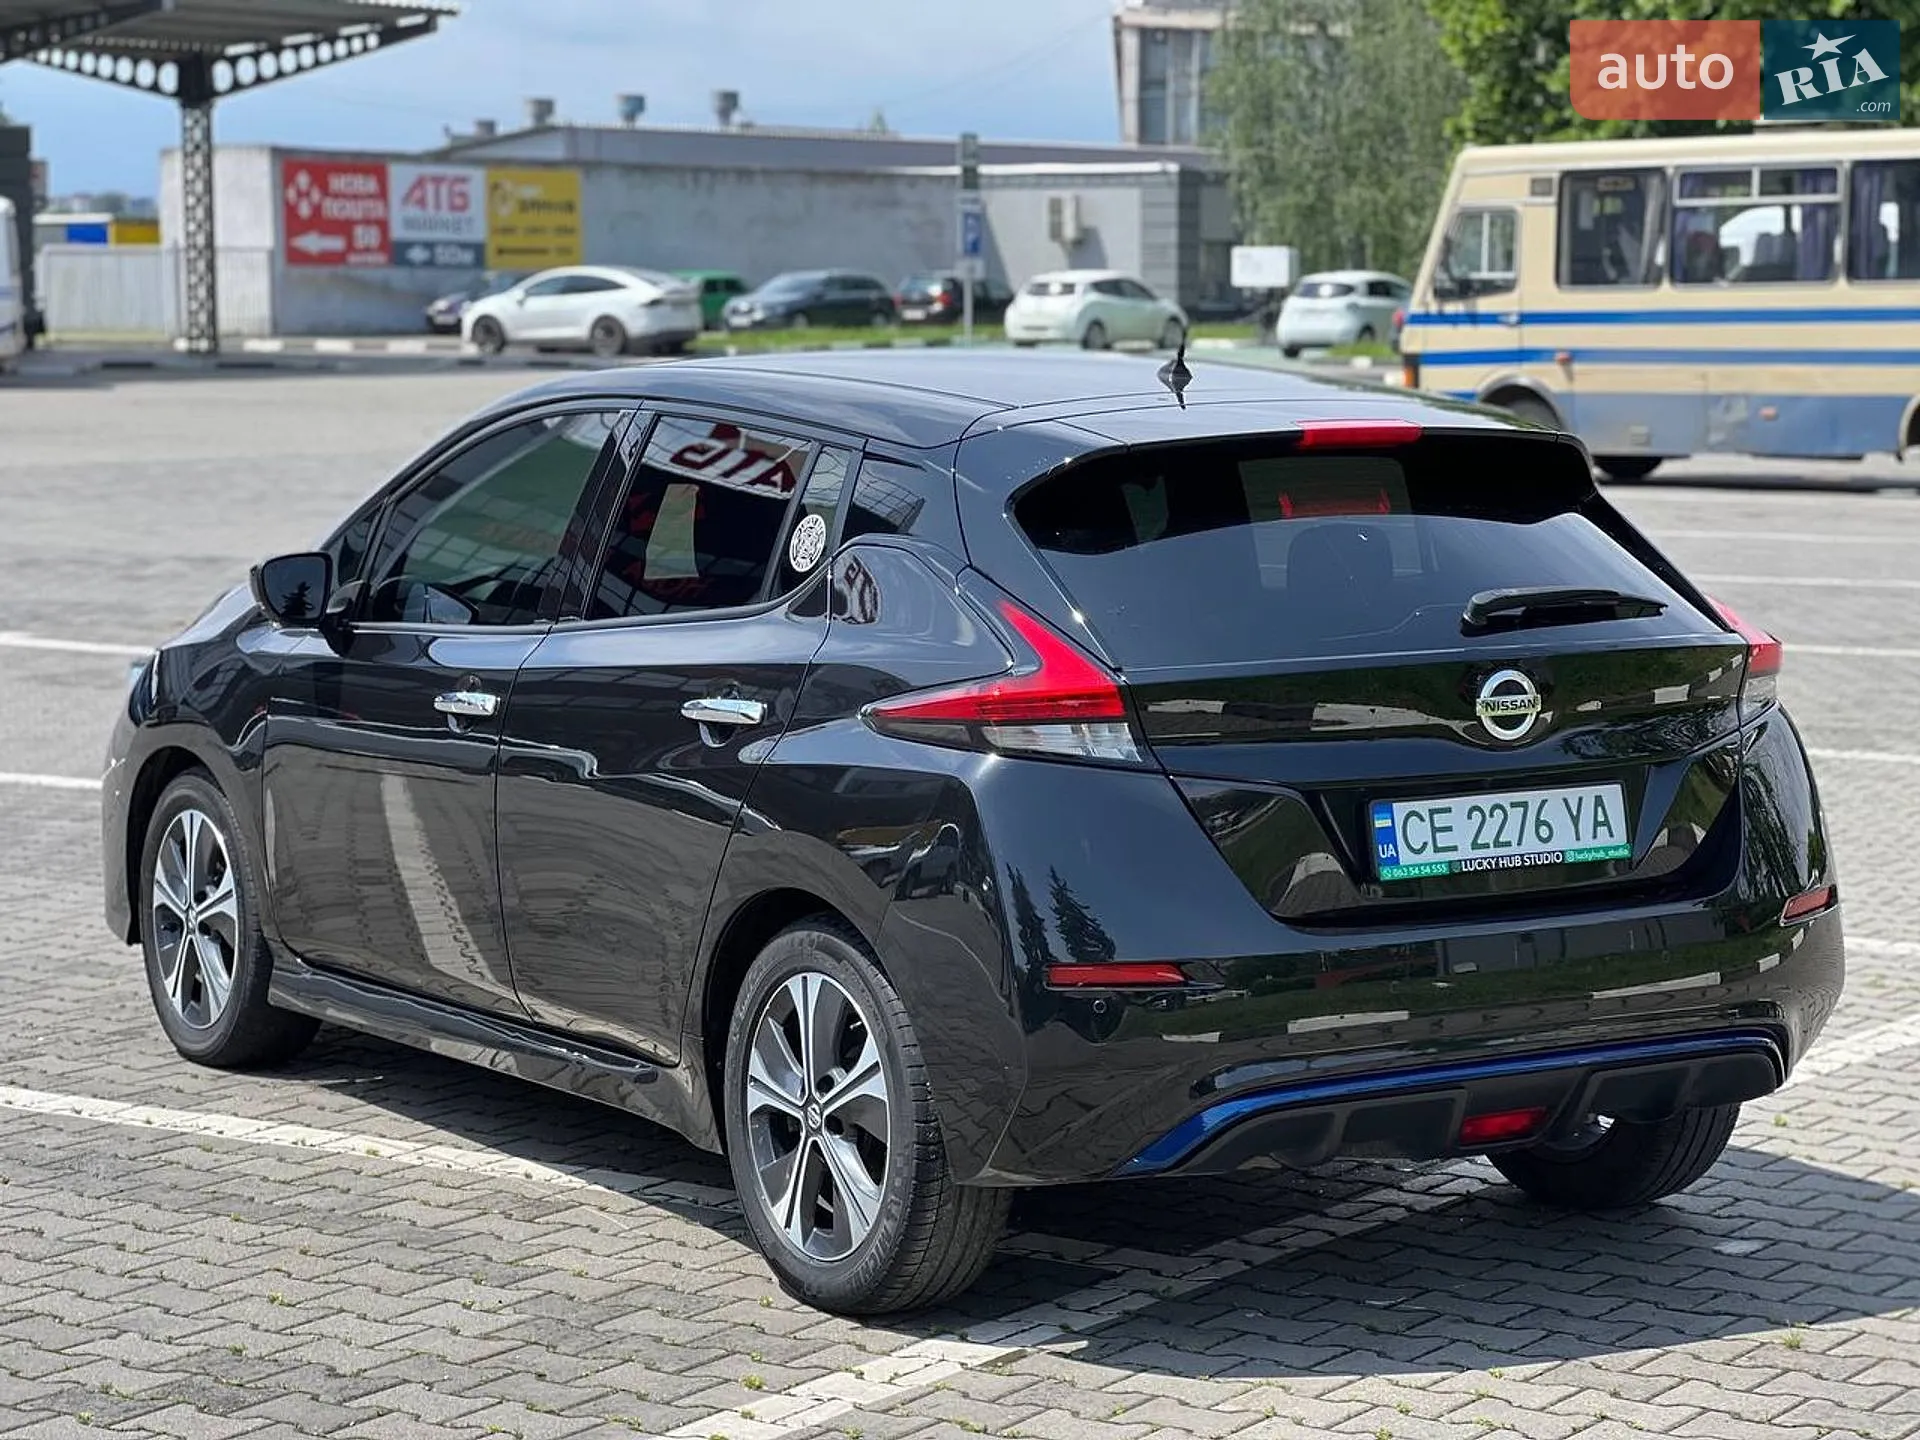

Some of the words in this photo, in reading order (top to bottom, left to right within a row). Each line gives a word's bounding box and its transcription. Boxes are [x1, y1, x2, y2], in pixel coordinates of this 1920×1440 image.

[327, 172, 380, 194] НОВА
[402, 173, 473, 212] АТБ
[321, 197, 386, 220] ПОШТА
[1484, 698, 1536, 712] NISSAN
[1402, 806, 1458, 855] CE
[1466, 799, 1554, 851] 2276
[1562, 794, 1615, 842] YA
[1378, 844, 1397, 859] UA
[1461, 858, 1497, 872] LUCKY
[1499, 855, 1522, 869] HUB
[1523, 851, 1563, 867] STUDIO
